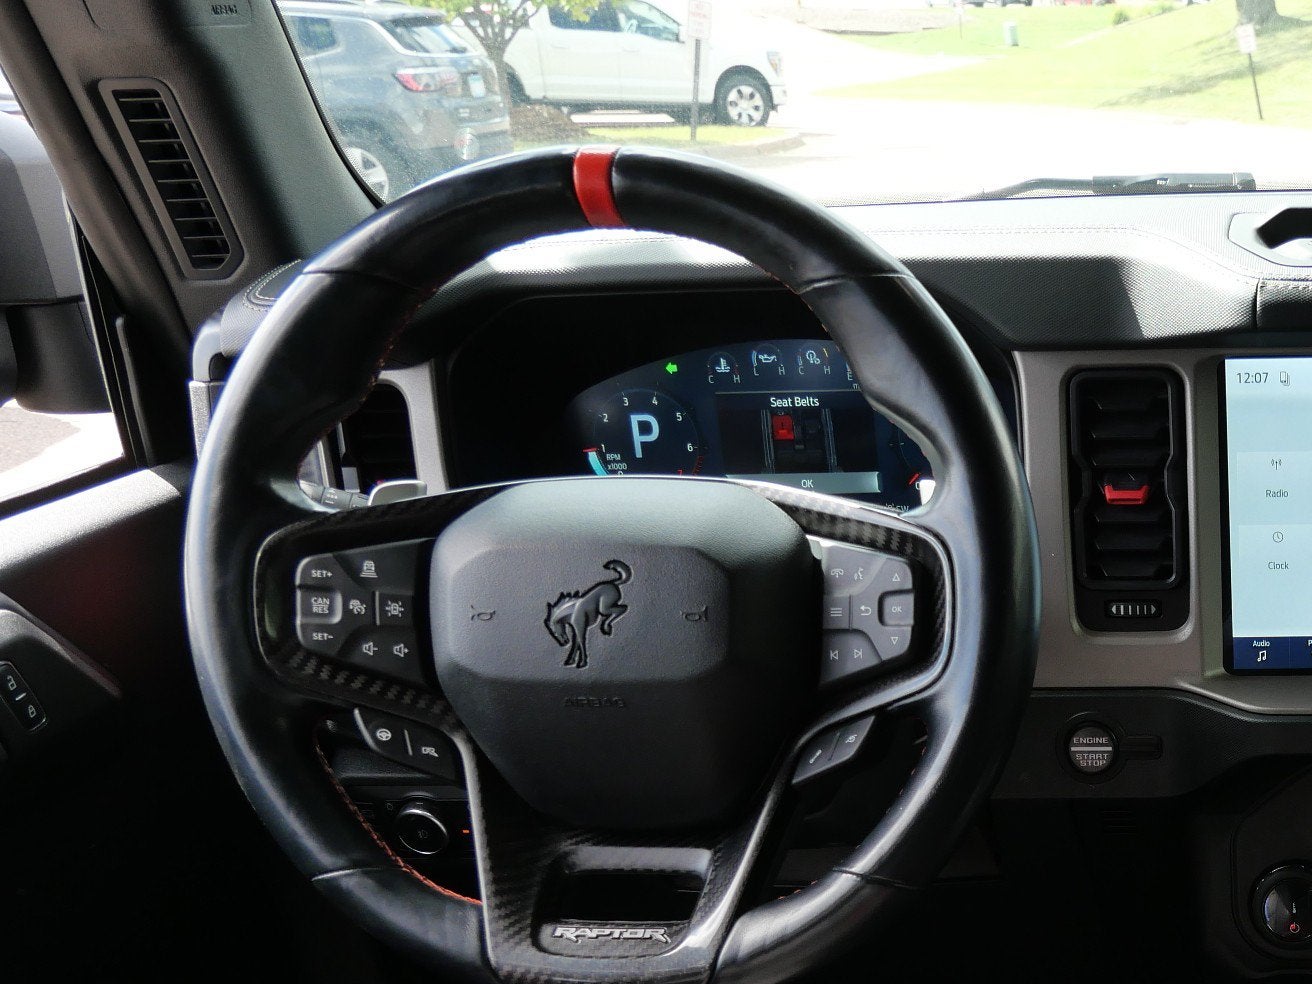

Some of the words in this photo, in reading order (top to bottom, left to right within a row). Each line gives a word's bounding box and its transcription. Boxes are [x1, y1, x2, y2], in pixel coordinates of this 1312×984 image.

[1237, 372, 1268, 384] 12:07
[623, 397, 629, 406] 3
[652, 396, 658, 406] 4
[770, 396, 793, 407] Seat
[795, 396, 820, 407] Belts
[603, 413, 609, 422] 2
[676, 413, 683, 422] 5
[630, 414, 660, 458] P
[687, 443, 693, 452] 6
[606, 453, 621, 461] RPM
[607, 463, 628, 471] x1000
[801, 479, 814, 488] OK
[1266, 488, 1288, 498] Radio
[1268, 561, 1288, 570] Clock
[311, 597, 330, 605] CAN
[311, 605, 329, 614] RES
[1253, 639, 1270, 647] Audio
[552, 927, 671, 944] RAPTOR
